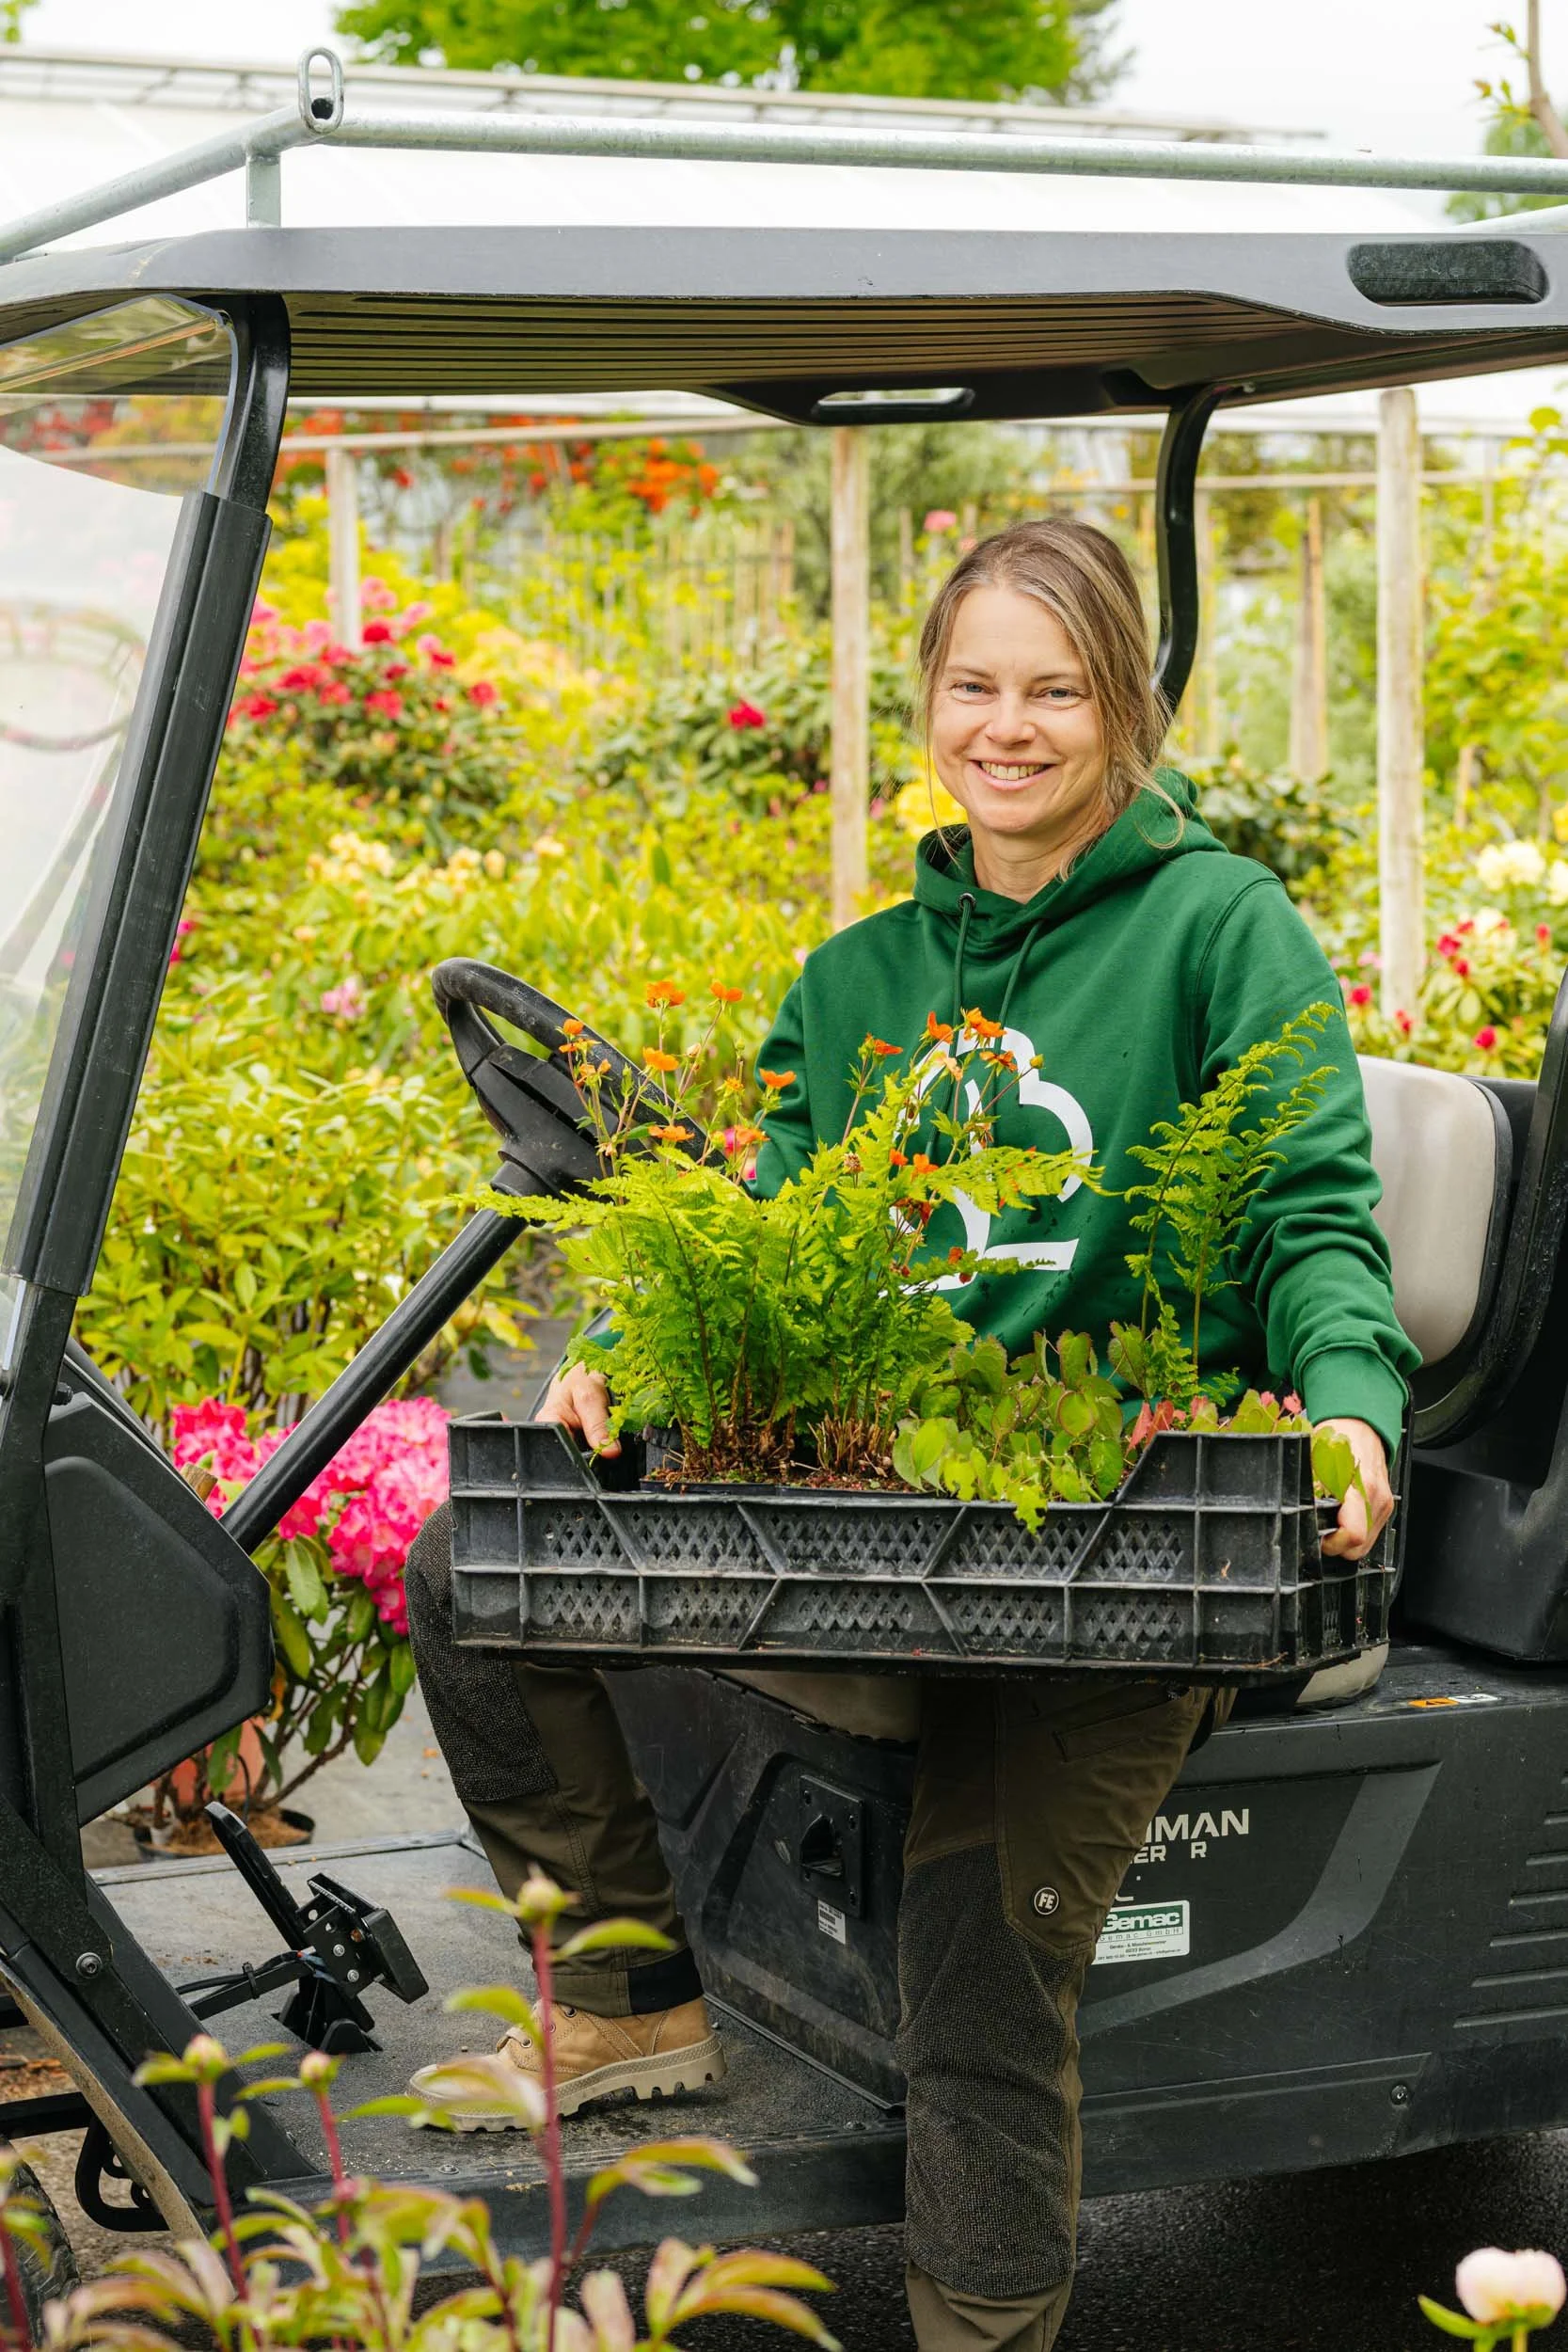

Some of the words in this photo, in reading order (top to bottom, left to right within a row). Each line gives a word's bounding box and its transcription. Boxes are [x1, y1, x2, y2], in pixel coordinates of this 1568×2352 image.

[1131, 1845, 1166, 1865] ER
[1191, 1841, 1207, 1859] R
[1037, 1892, 1055, 1910] FE
